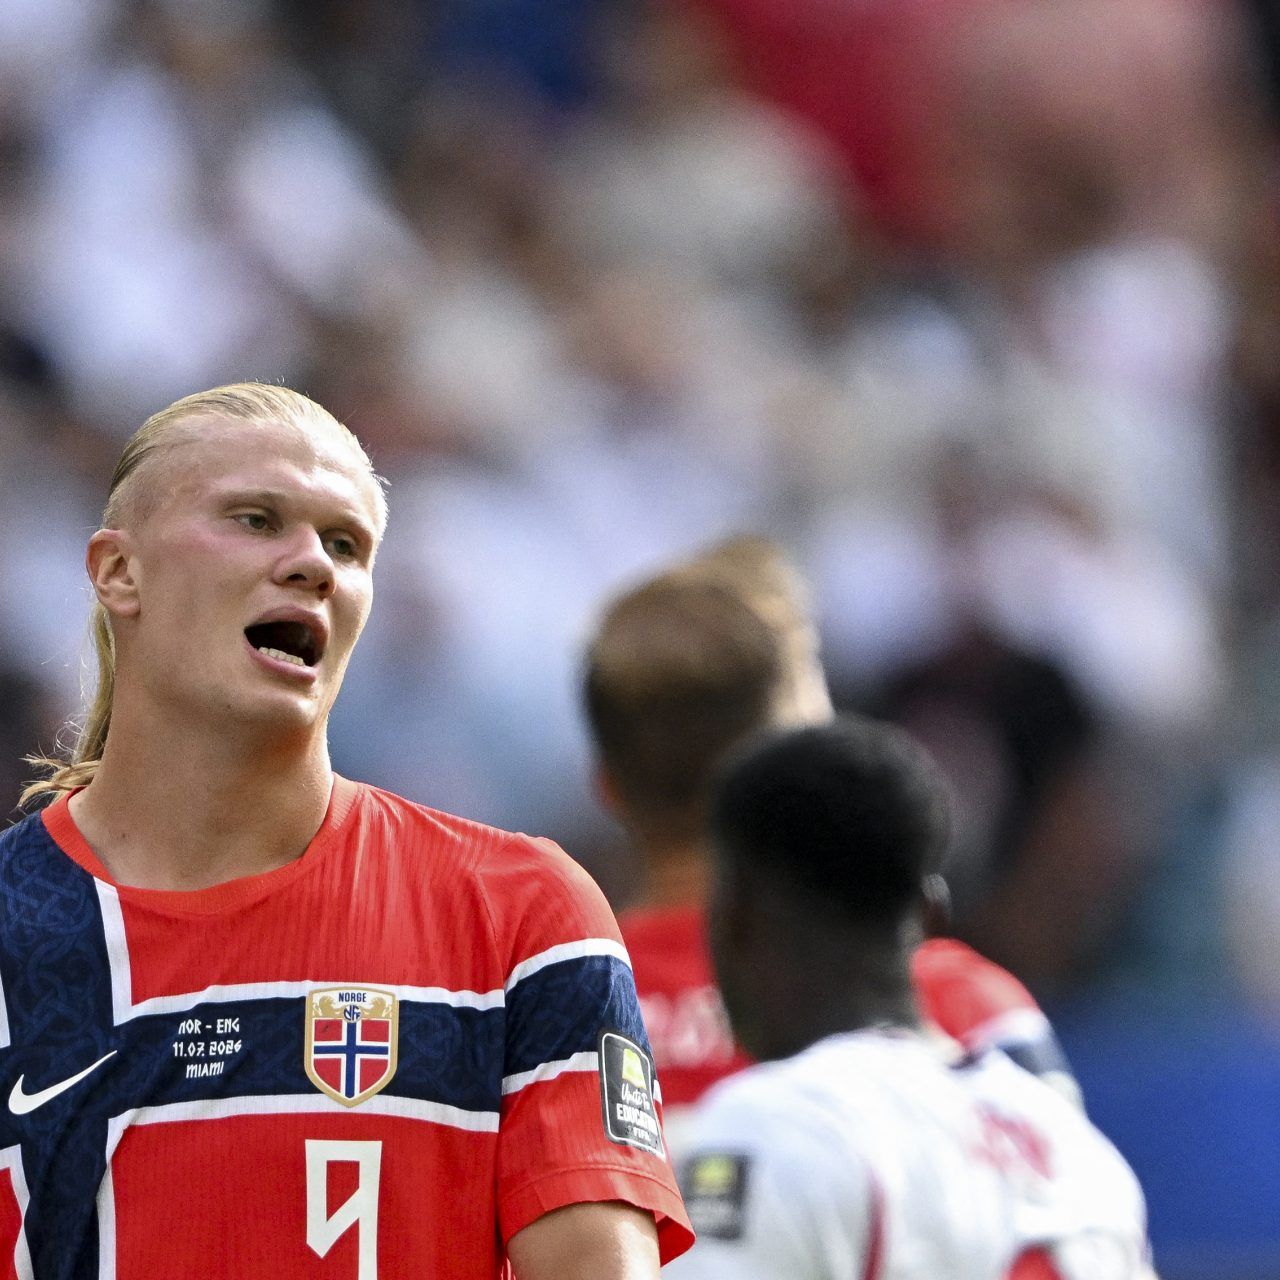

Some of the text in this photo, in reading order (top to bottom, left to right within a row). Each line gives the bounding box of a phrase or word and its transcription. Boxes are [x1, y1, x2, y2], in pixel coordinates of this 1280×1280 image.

[338, 992, 367, 1003] NORGE
[178, 1018, 202, 1035] NOR
[216, 1017, 240, 1034] ENG
[185, 1061, 225, 1079] MIAMI
